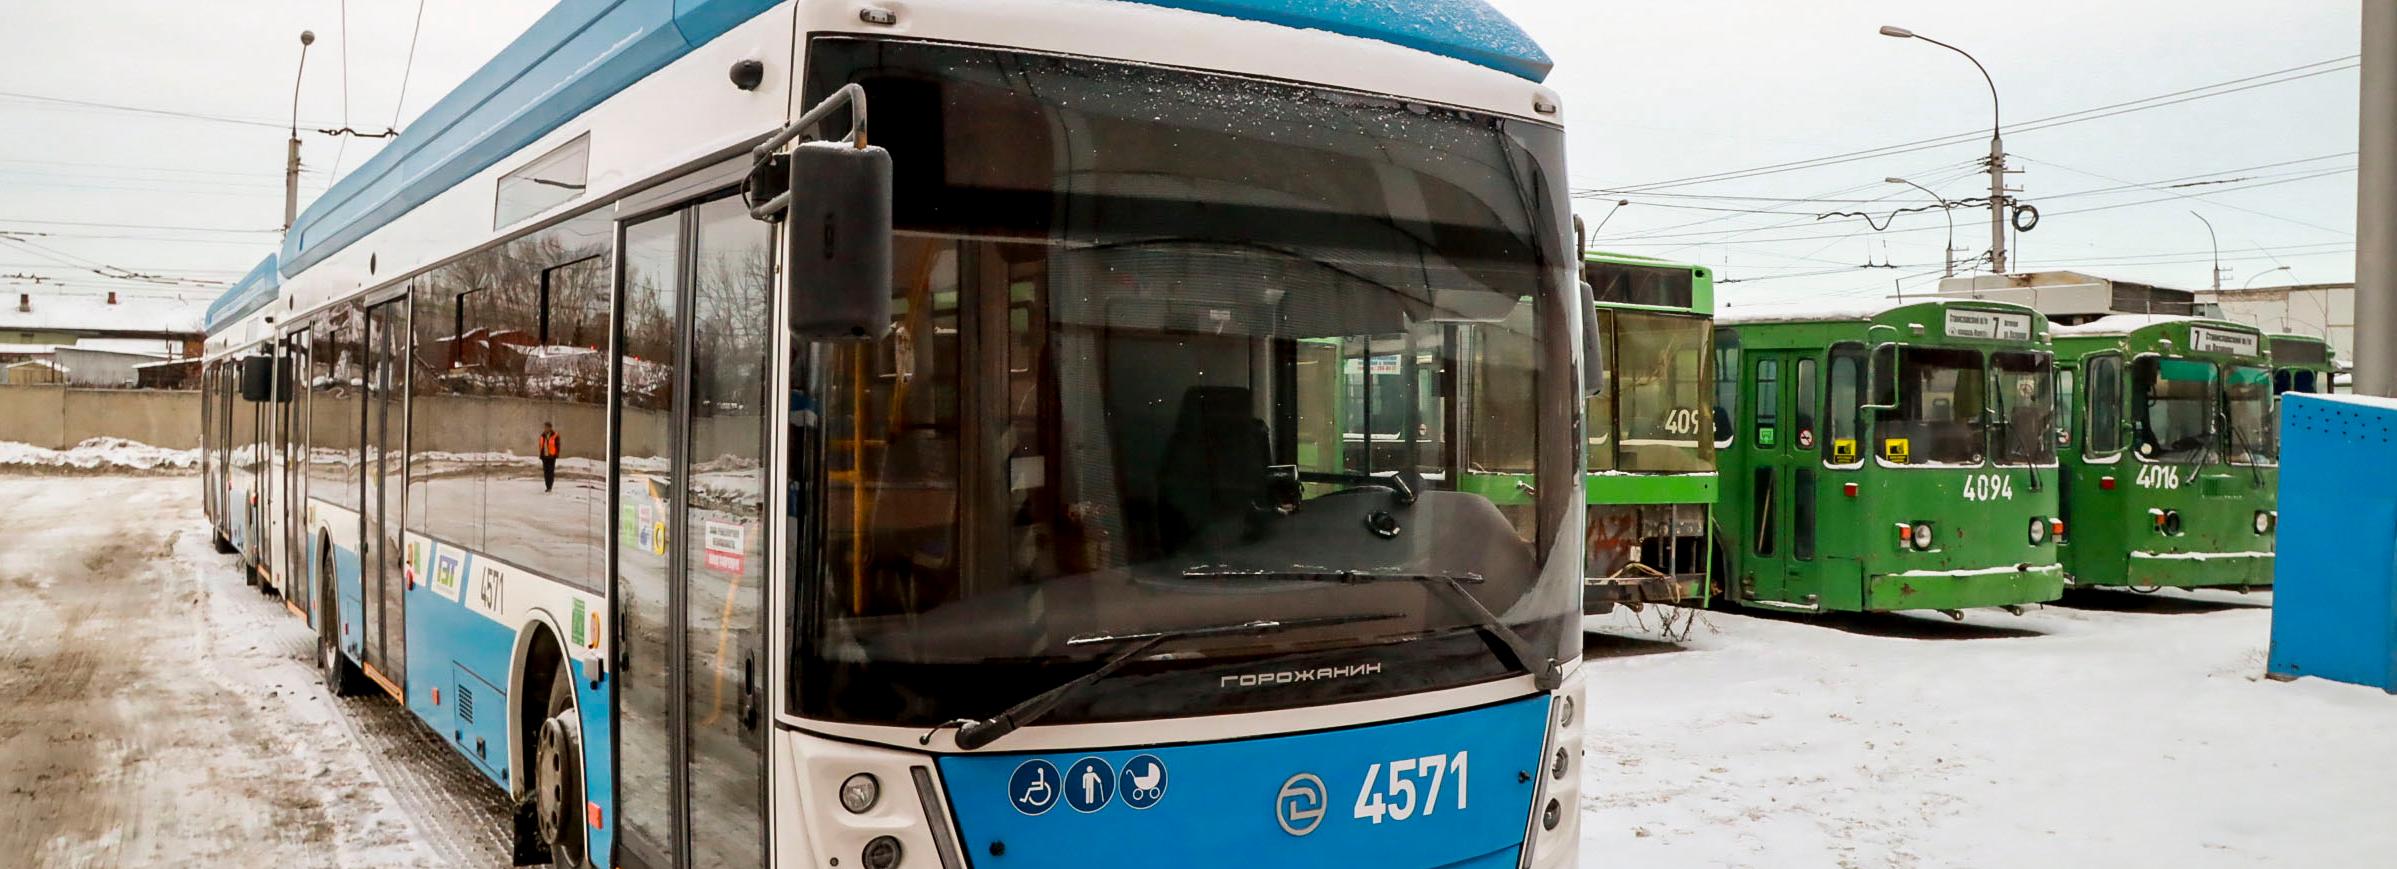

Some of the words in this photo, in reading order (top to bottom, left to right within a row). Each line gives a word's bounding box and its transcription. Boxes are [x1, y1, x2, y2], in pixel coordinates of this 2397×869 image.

[1993, 317, 1999, 338] 7
[2195, 330, 2200, 351] 7
[1665, 409, 1717, 434] 409
[1963, 474, 2013, 501] 4094
[2136, 465, 2179, 490] 4016
[481, 566, 504, 615] 4571
[1220, 662, 1382, 688] ГОРОЖАНИН
[1354, 750, 1468, 824] 4571
